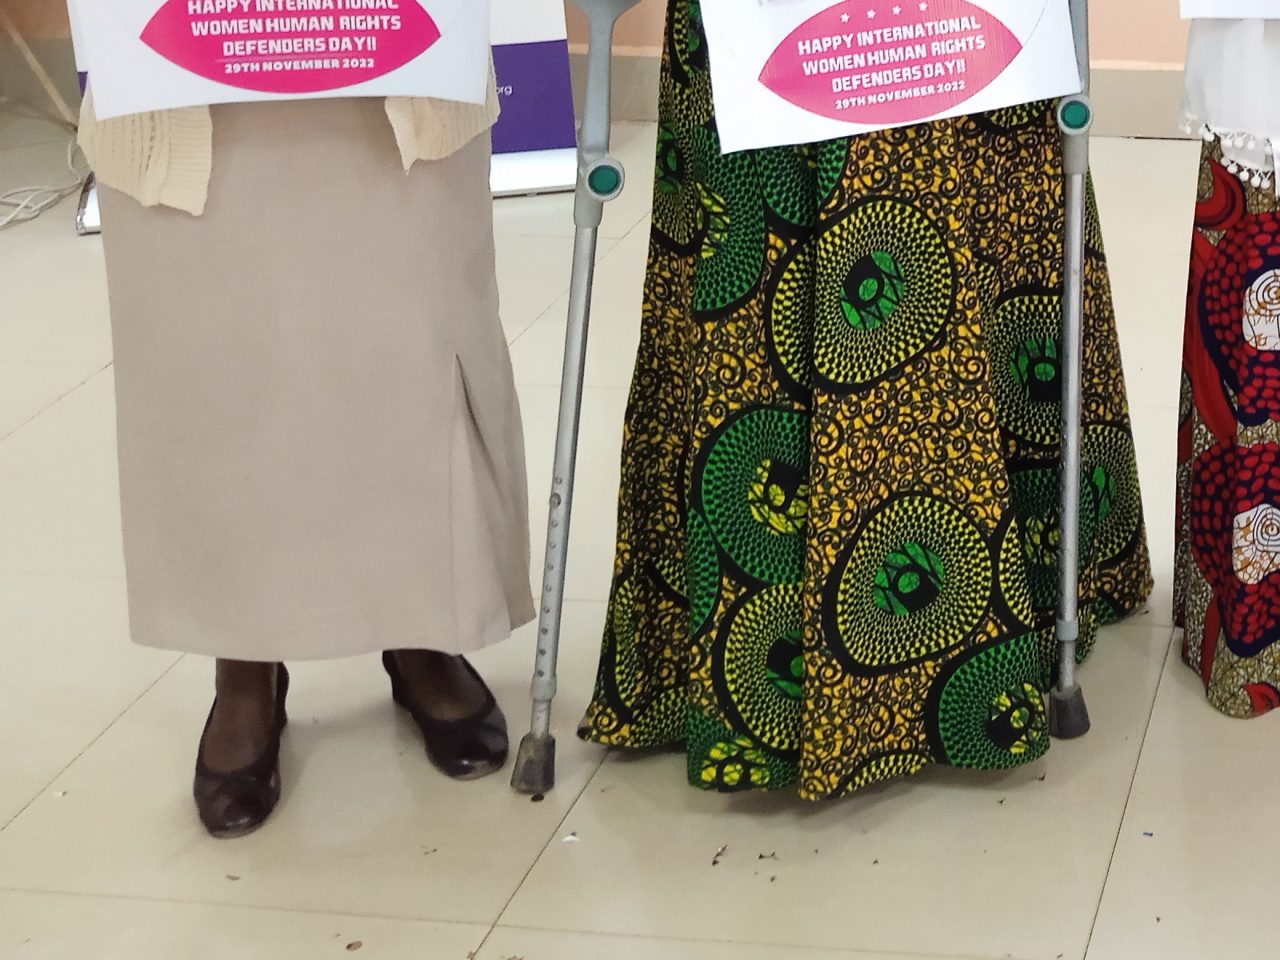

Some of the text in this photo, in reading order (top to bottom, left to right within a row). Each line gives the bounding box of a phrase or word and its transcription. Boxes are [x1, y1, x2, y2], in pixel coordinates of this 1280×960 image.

[190, 15, 401, 36] WOMEN HUMAN RIGHTS
[798, 15, 981, 56] HAPPY INTERNATIONAL
[222, 38, 325, 56] DEFENDERS
[803, 35, 985, 76] WOMEN HUMAN RIGHTS
[224, 58, 375, 74] 29TH NOVEMBER 2022
[832, 67, 921, 93] DEFENDERS
